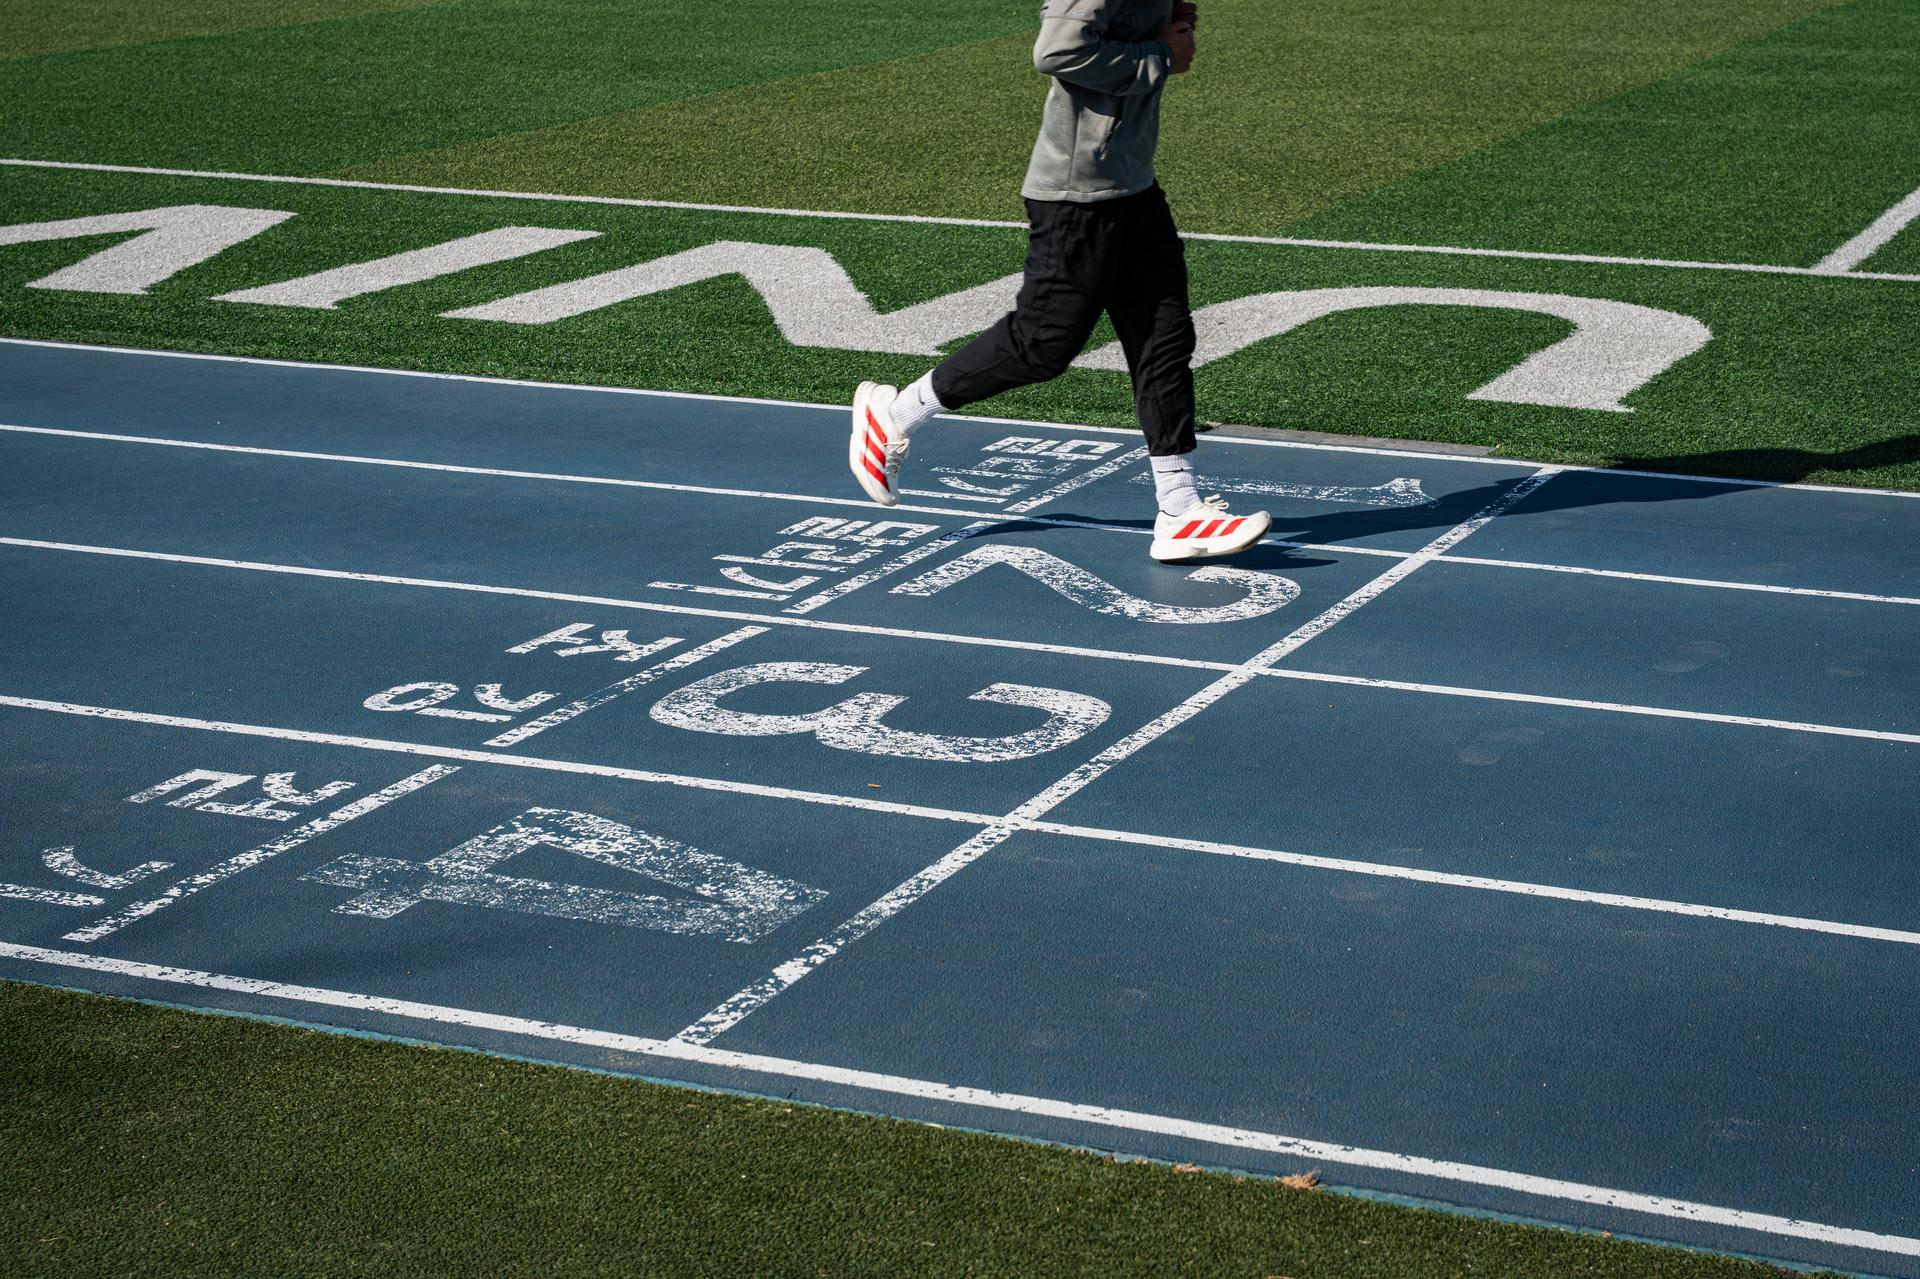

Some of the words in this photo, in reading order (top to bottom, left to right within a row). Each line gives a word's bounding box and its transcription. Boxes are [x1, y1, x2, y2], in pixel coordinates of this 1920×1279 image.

[897, 436, 1124, 503] 달리기
[1129, 470, 1437, 508] 1
[646, 516, 941, 601] 달리기
[889, 544, 1301, 624] 2
[649, 661, 1112, 763] 3
[297, 806, 830, 945] 4
